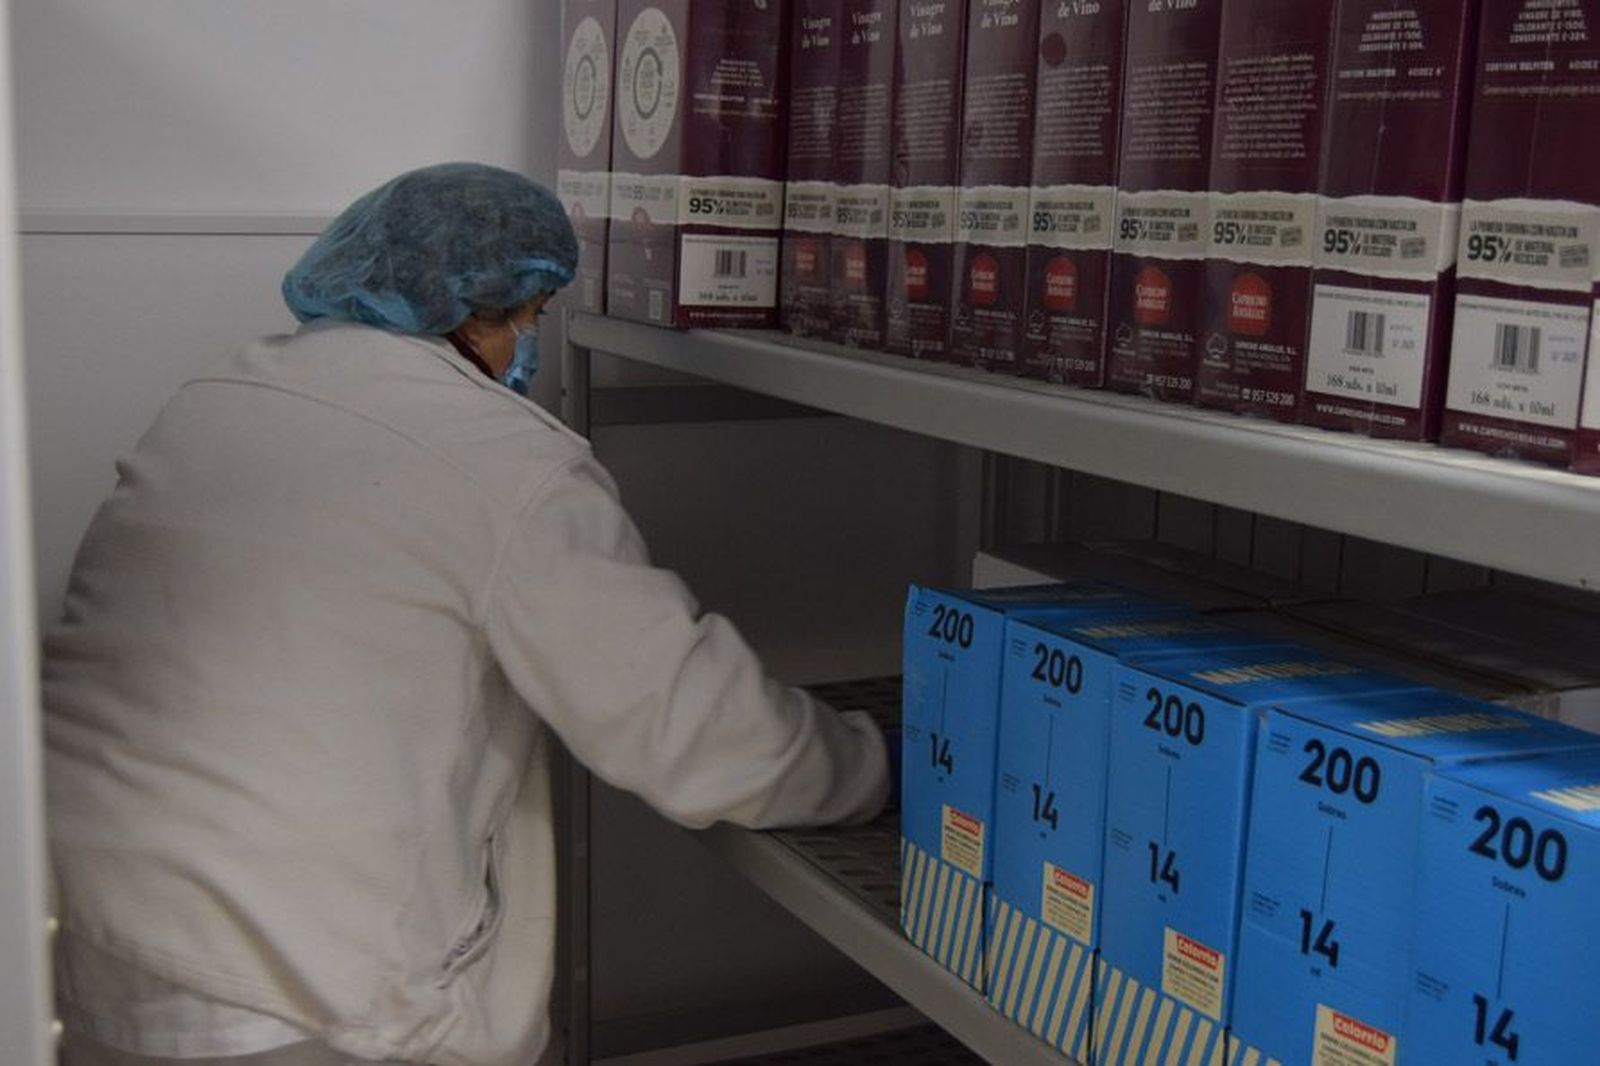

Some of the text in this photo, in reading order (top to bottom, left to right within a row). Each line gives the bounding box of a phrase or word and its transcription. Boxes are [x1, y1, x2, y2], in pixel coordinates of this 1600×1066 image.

[981, 12, 1019, 28] de Vino
[1057, 1, 1100, 18] de Vino
[689, 198, 725, 215] 95%
[1033, 211, 1055, 232] 95%
[1120, 219, 1147, 241] 95%
[1213, 221, 1246, 245] 95%
[1323, 229, 1361, 255] 95%
[1467, 234, 1512, 263] 95%
[928, 603, 974, 649] 200
[1031, 642, 1083, 694] 200
[1143, 687, 1205, 746] 200
[930, 732, 953, 775] 14
[1299, 738, 1381, 804] 200
[1032, 783, 1058, 832] 14
[1468, 805, 1568, 882] 200
[1148, 841, 1179, 895] 14
[1491, 875, 1527, 898] Sobres
[1300, 908, 1339, 969] 14
[1473, 992, 1519, 1062] 14
